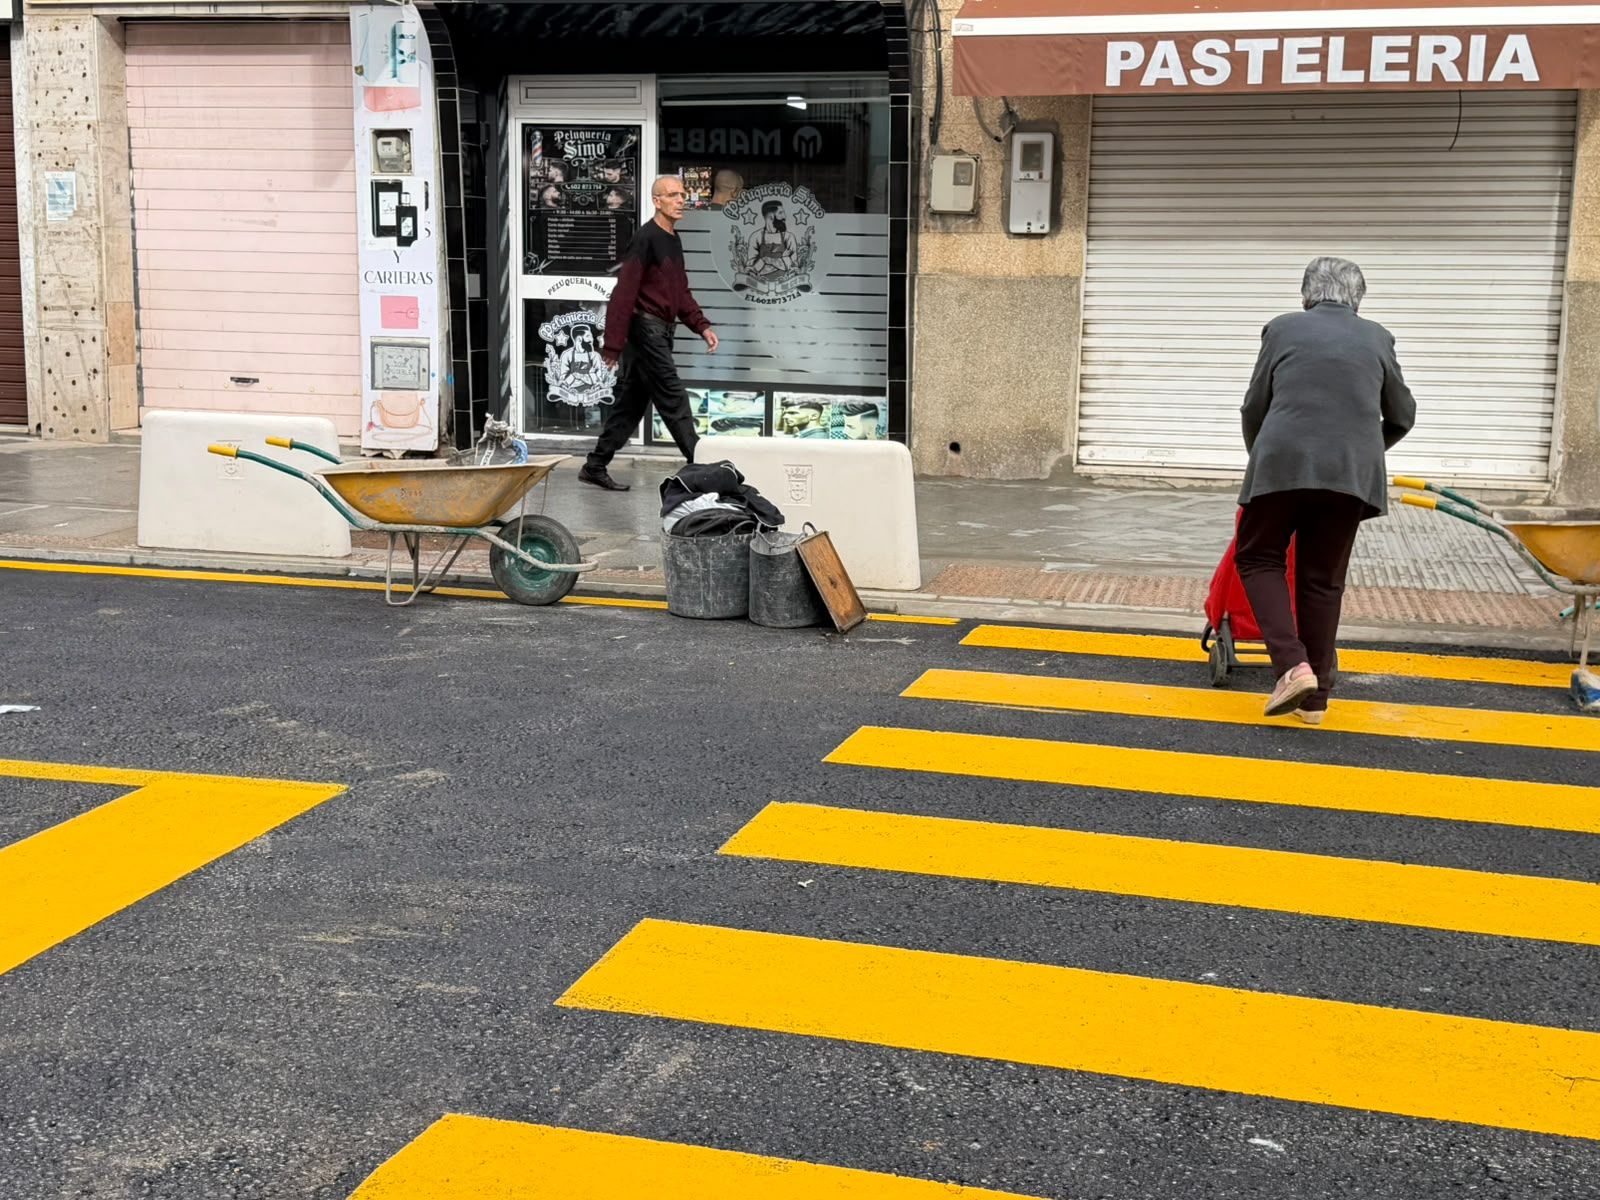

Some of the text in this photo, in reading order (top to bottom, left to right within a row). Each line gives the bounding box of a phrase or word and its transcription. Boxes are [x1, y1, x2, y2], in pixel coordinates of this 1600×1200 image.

[1104, 34, 1540, 87] PASTELERIA
[562, 140, 606, 162] Simo
[791, 186, 826, 219] Simo
[393, 250, 403, 264] Y
[364, 270, 433, 285] CARTERAS
